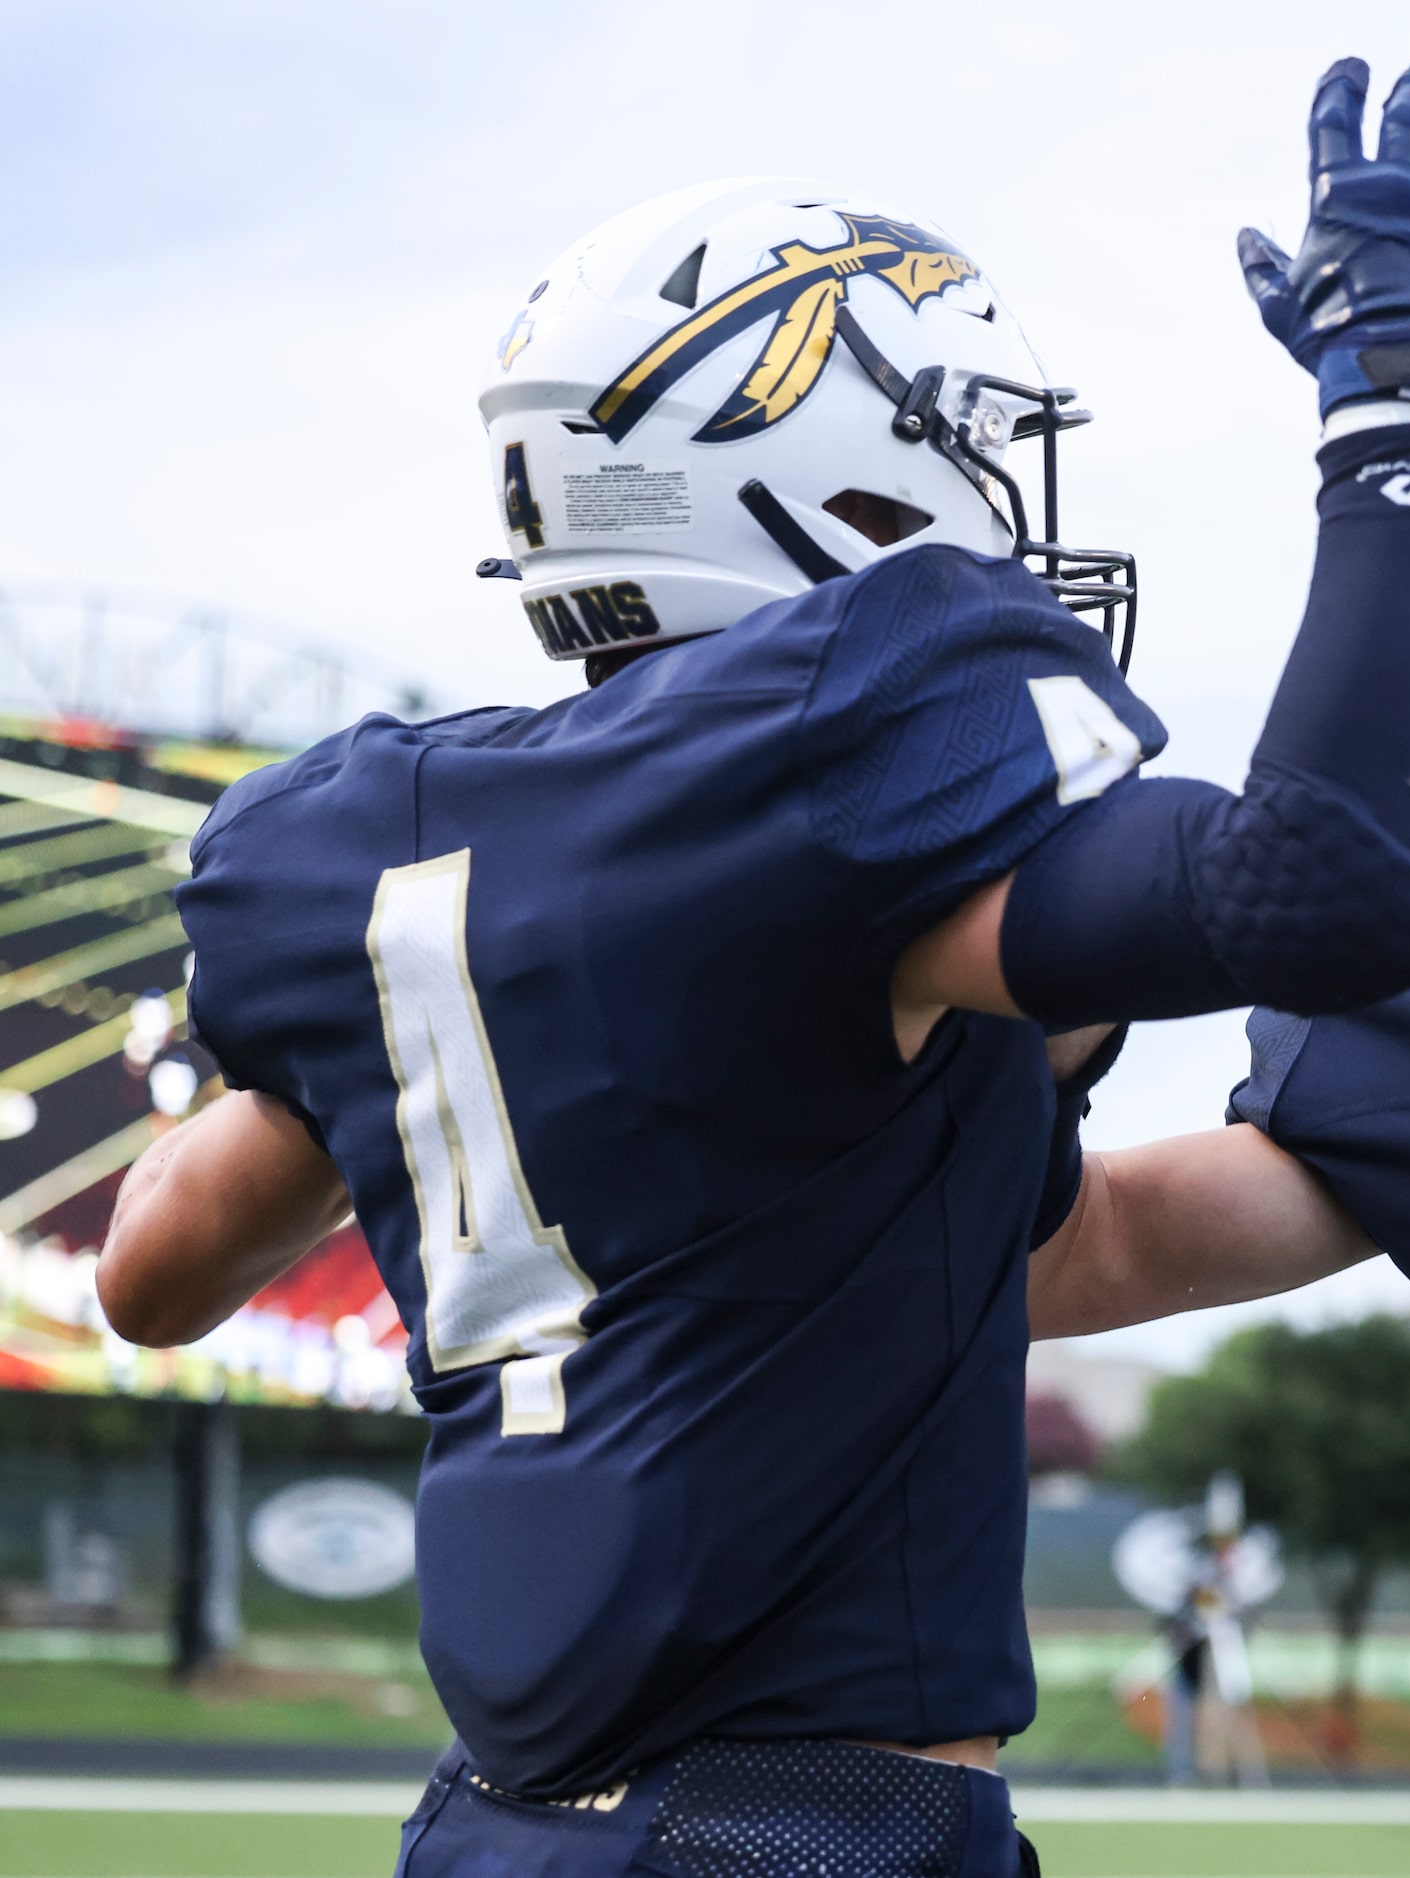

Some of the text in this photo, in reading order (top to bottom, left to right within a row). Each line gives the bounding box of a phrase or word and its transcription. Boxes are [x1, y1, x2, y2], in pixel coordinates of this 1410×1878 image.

[505, 441, 545, 549] 4
[600, 464, 645, 473] WARNING
[526, 580, 661, 655] IANS
[1026, 675, 1144, 807] 4
[366, 847, 599, 1436] 4
